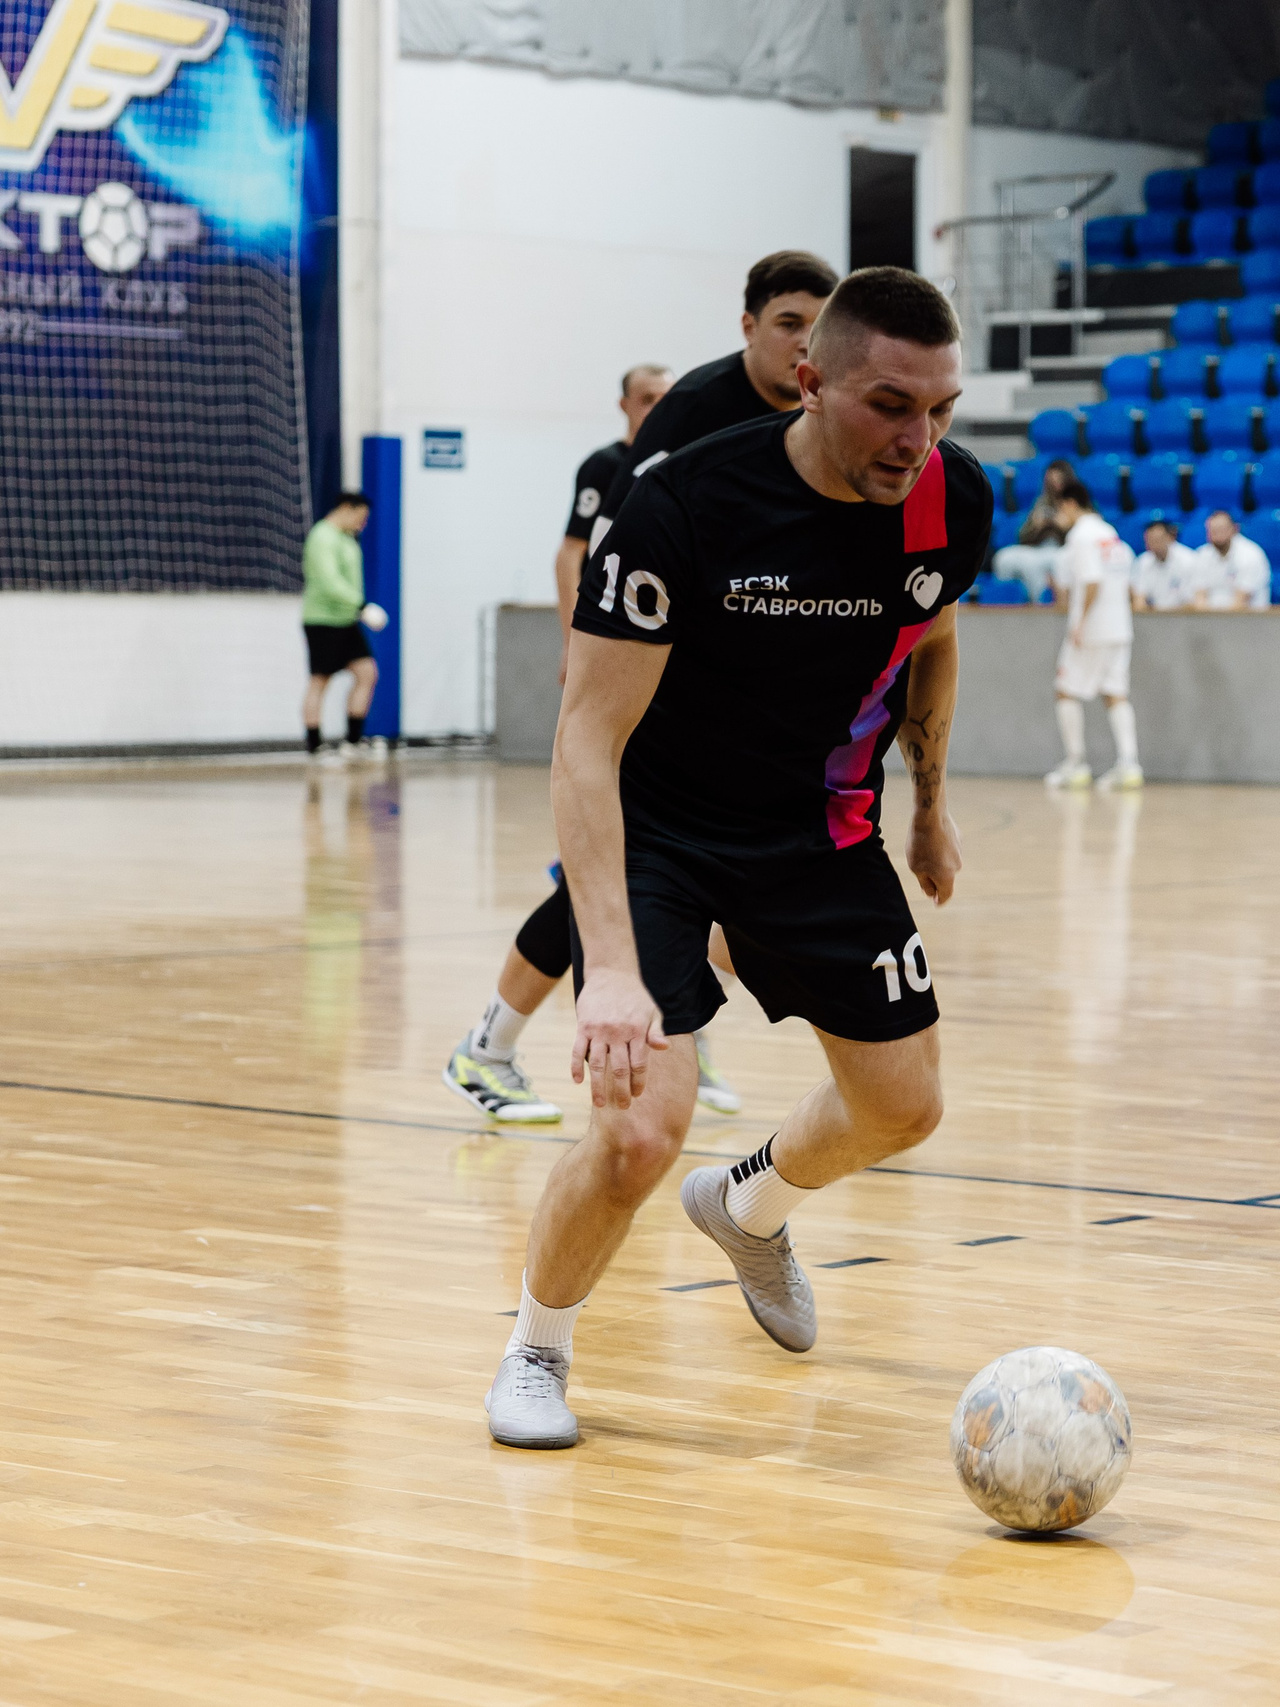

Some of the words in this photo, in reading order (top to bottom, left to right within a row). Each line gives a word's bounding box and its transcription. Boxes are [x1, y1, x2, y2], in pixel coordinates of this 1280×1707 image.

[598, 552, 671, 631] 10
[723, 593, 884, 617] СТАВРОПОЛЬ
[729, 574, 790, 594] ЕСЗК
[871, 931, 932, 1003] 10
